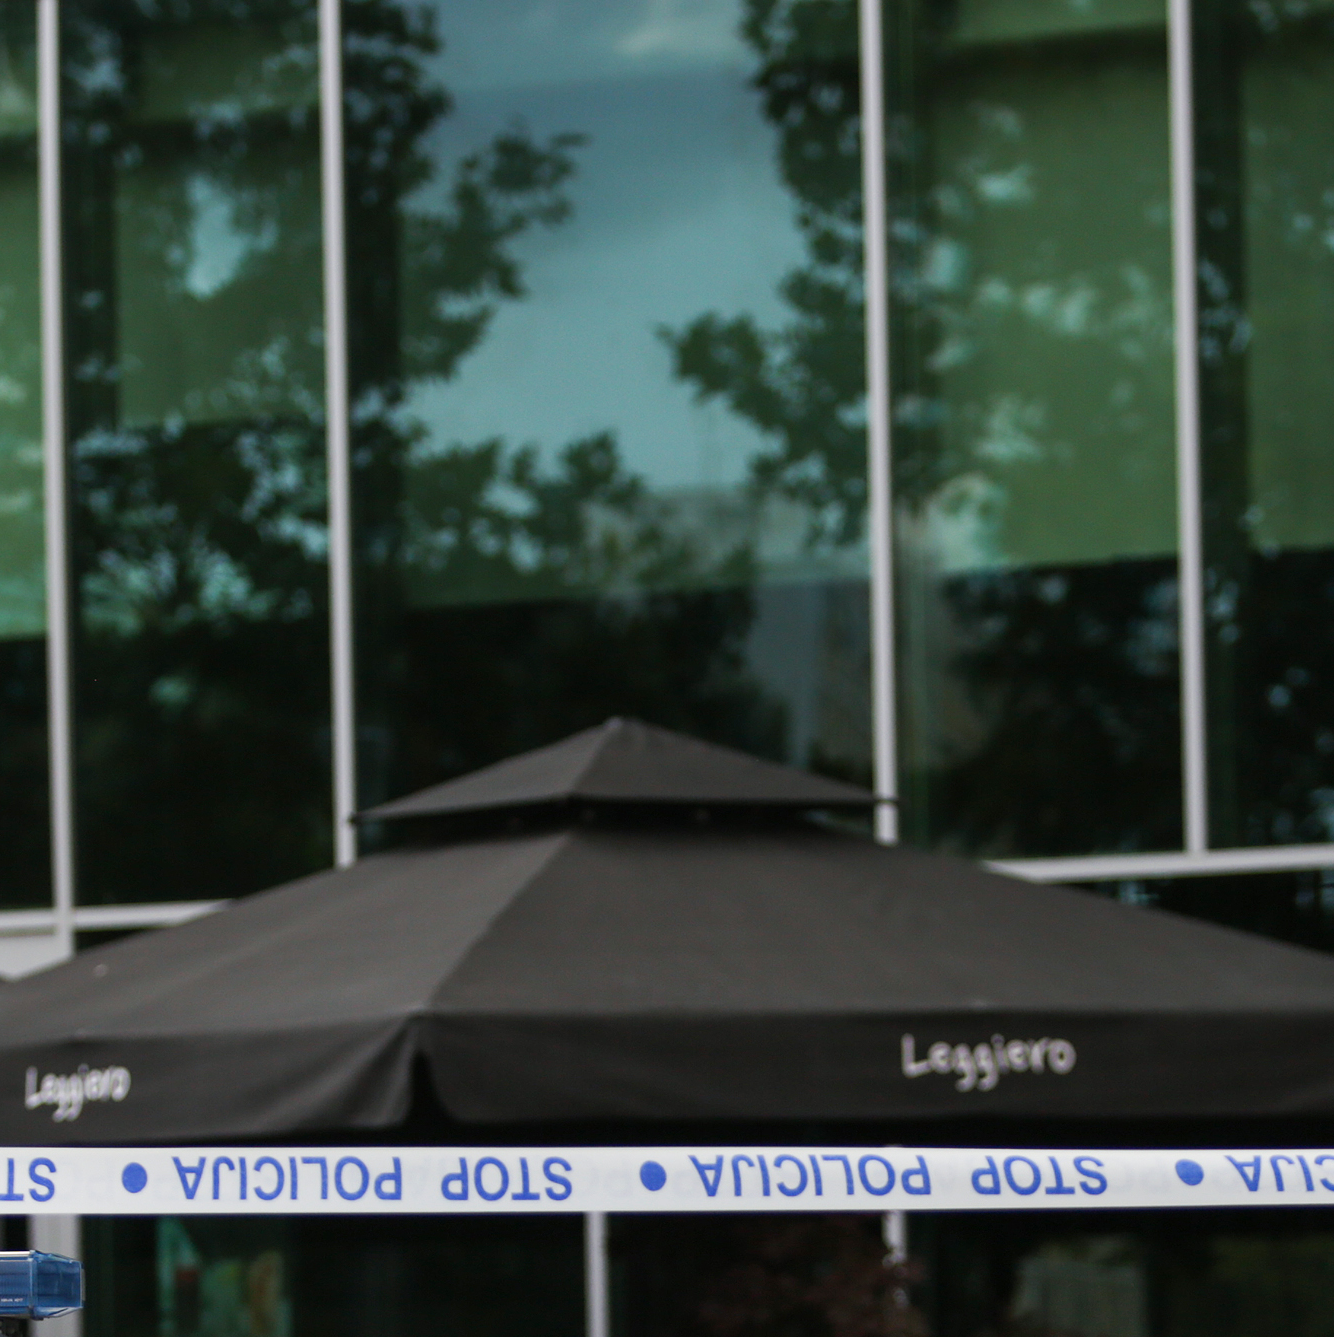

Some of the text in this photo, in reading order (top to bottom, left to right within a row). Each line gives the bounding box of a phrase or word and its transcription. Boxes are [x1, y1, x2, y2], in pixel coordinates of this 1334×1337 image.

[900, 1033, 1078, 1093] Leggiero
[172, 1156, 573, 1202] STOP POLICIJA
[689, 1154, 1108, 1198] STOP POLICIJA
